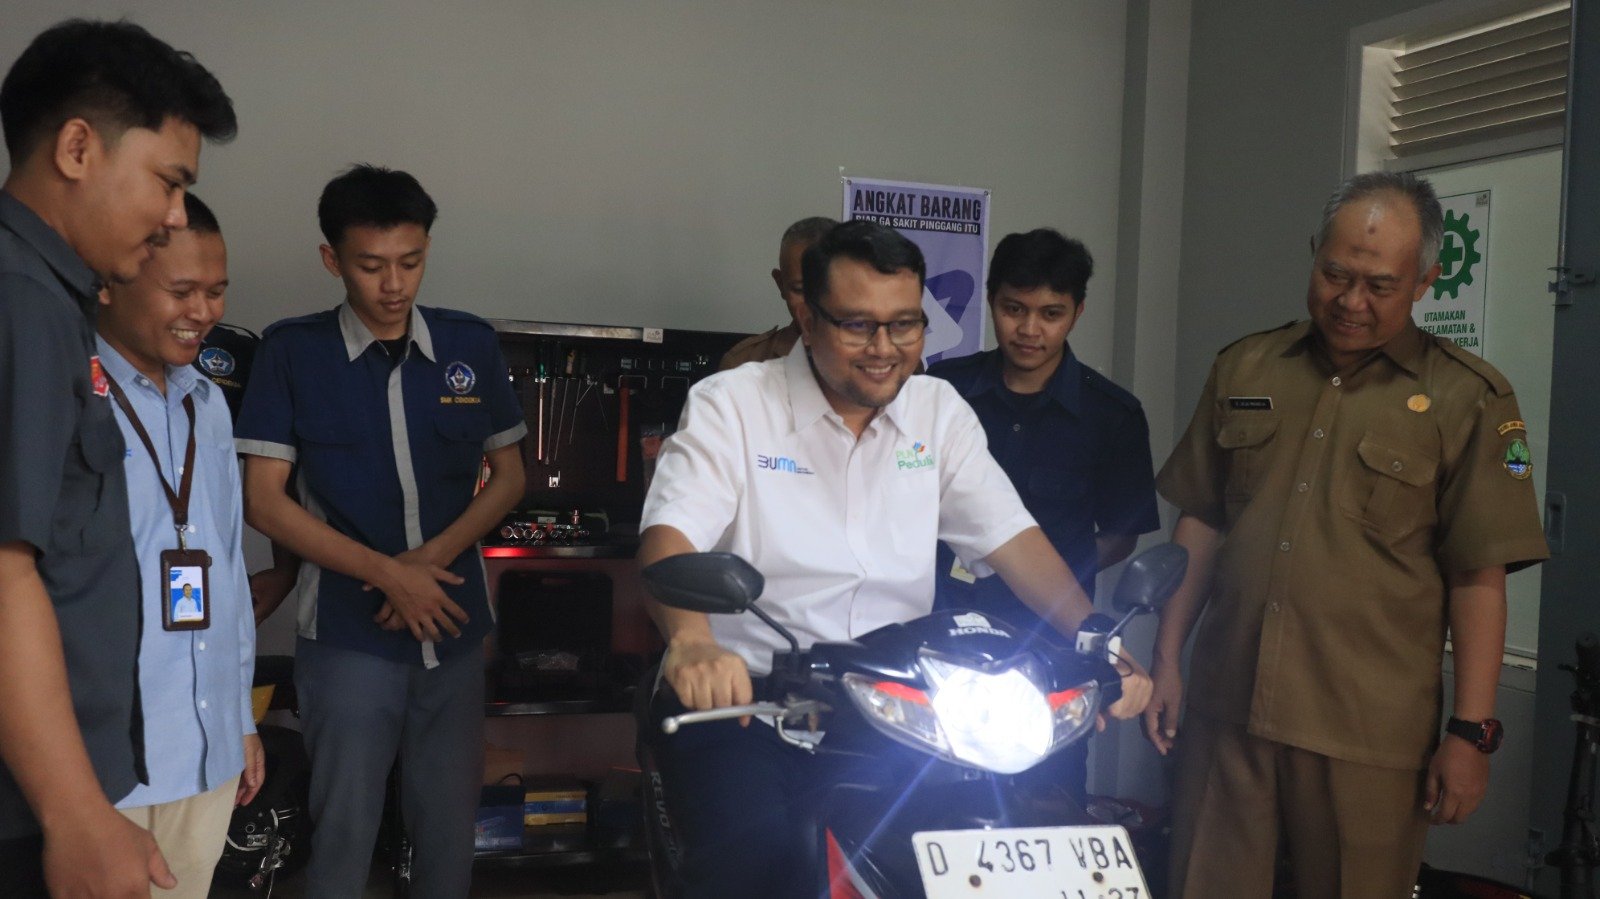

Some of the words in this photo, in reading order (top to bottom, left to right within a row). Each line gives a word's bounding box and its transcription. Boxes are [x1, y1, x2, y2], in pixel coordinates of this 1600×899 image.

[854, 190, 915, 215] ANGKAT
[921, 196, 981, 221] BARANG
[879, 217, 891, 227] GA
[893, 218, 917, 228] SAKIT
[920, 221, 962, 232] PINGGANG
[964, 224, 978, 234] ITU
[1424, 310, 1466, 322] UTAMAKAN
[1419, 323, 1468, 335] SELAMATAN
[897, 454, 935, 470] Peduli
[948, 626, 1012, 639] HONDA
[650, 771, 672, 829] REVO
[927, 842, 949, 876] D
[977, 839, 1052, 873] 4367
[1069, 836, 1133, 869] VBA
